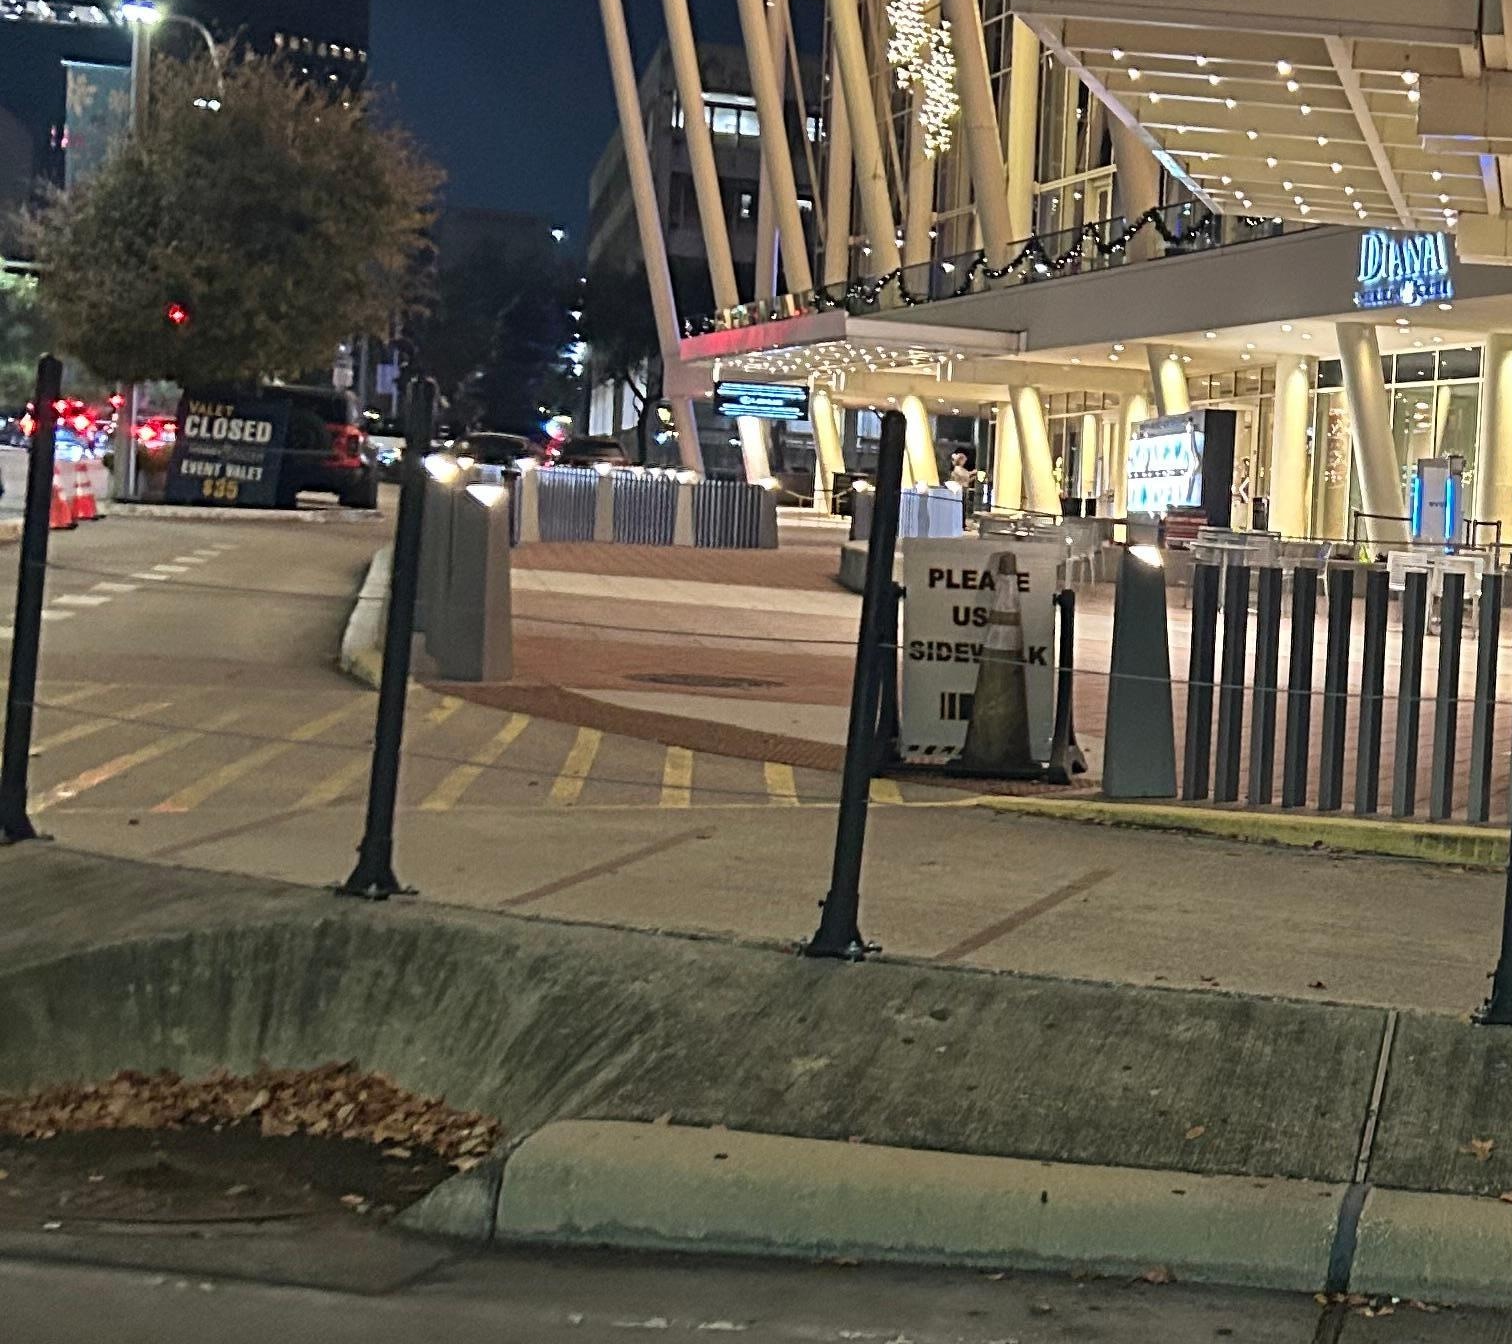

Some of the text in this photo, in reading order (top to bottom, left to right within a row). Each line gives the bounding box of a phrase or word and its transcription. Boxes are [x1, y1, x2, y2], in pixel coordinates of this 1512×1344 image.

[184, 415, 273, 444] CLOSED
[181, 459, 222, 477] EVENT
[928, 568, 1031, 593] PLEAE
[952, 606, 990, 627] US
[909, 641, 1047, 666] SIDEK
